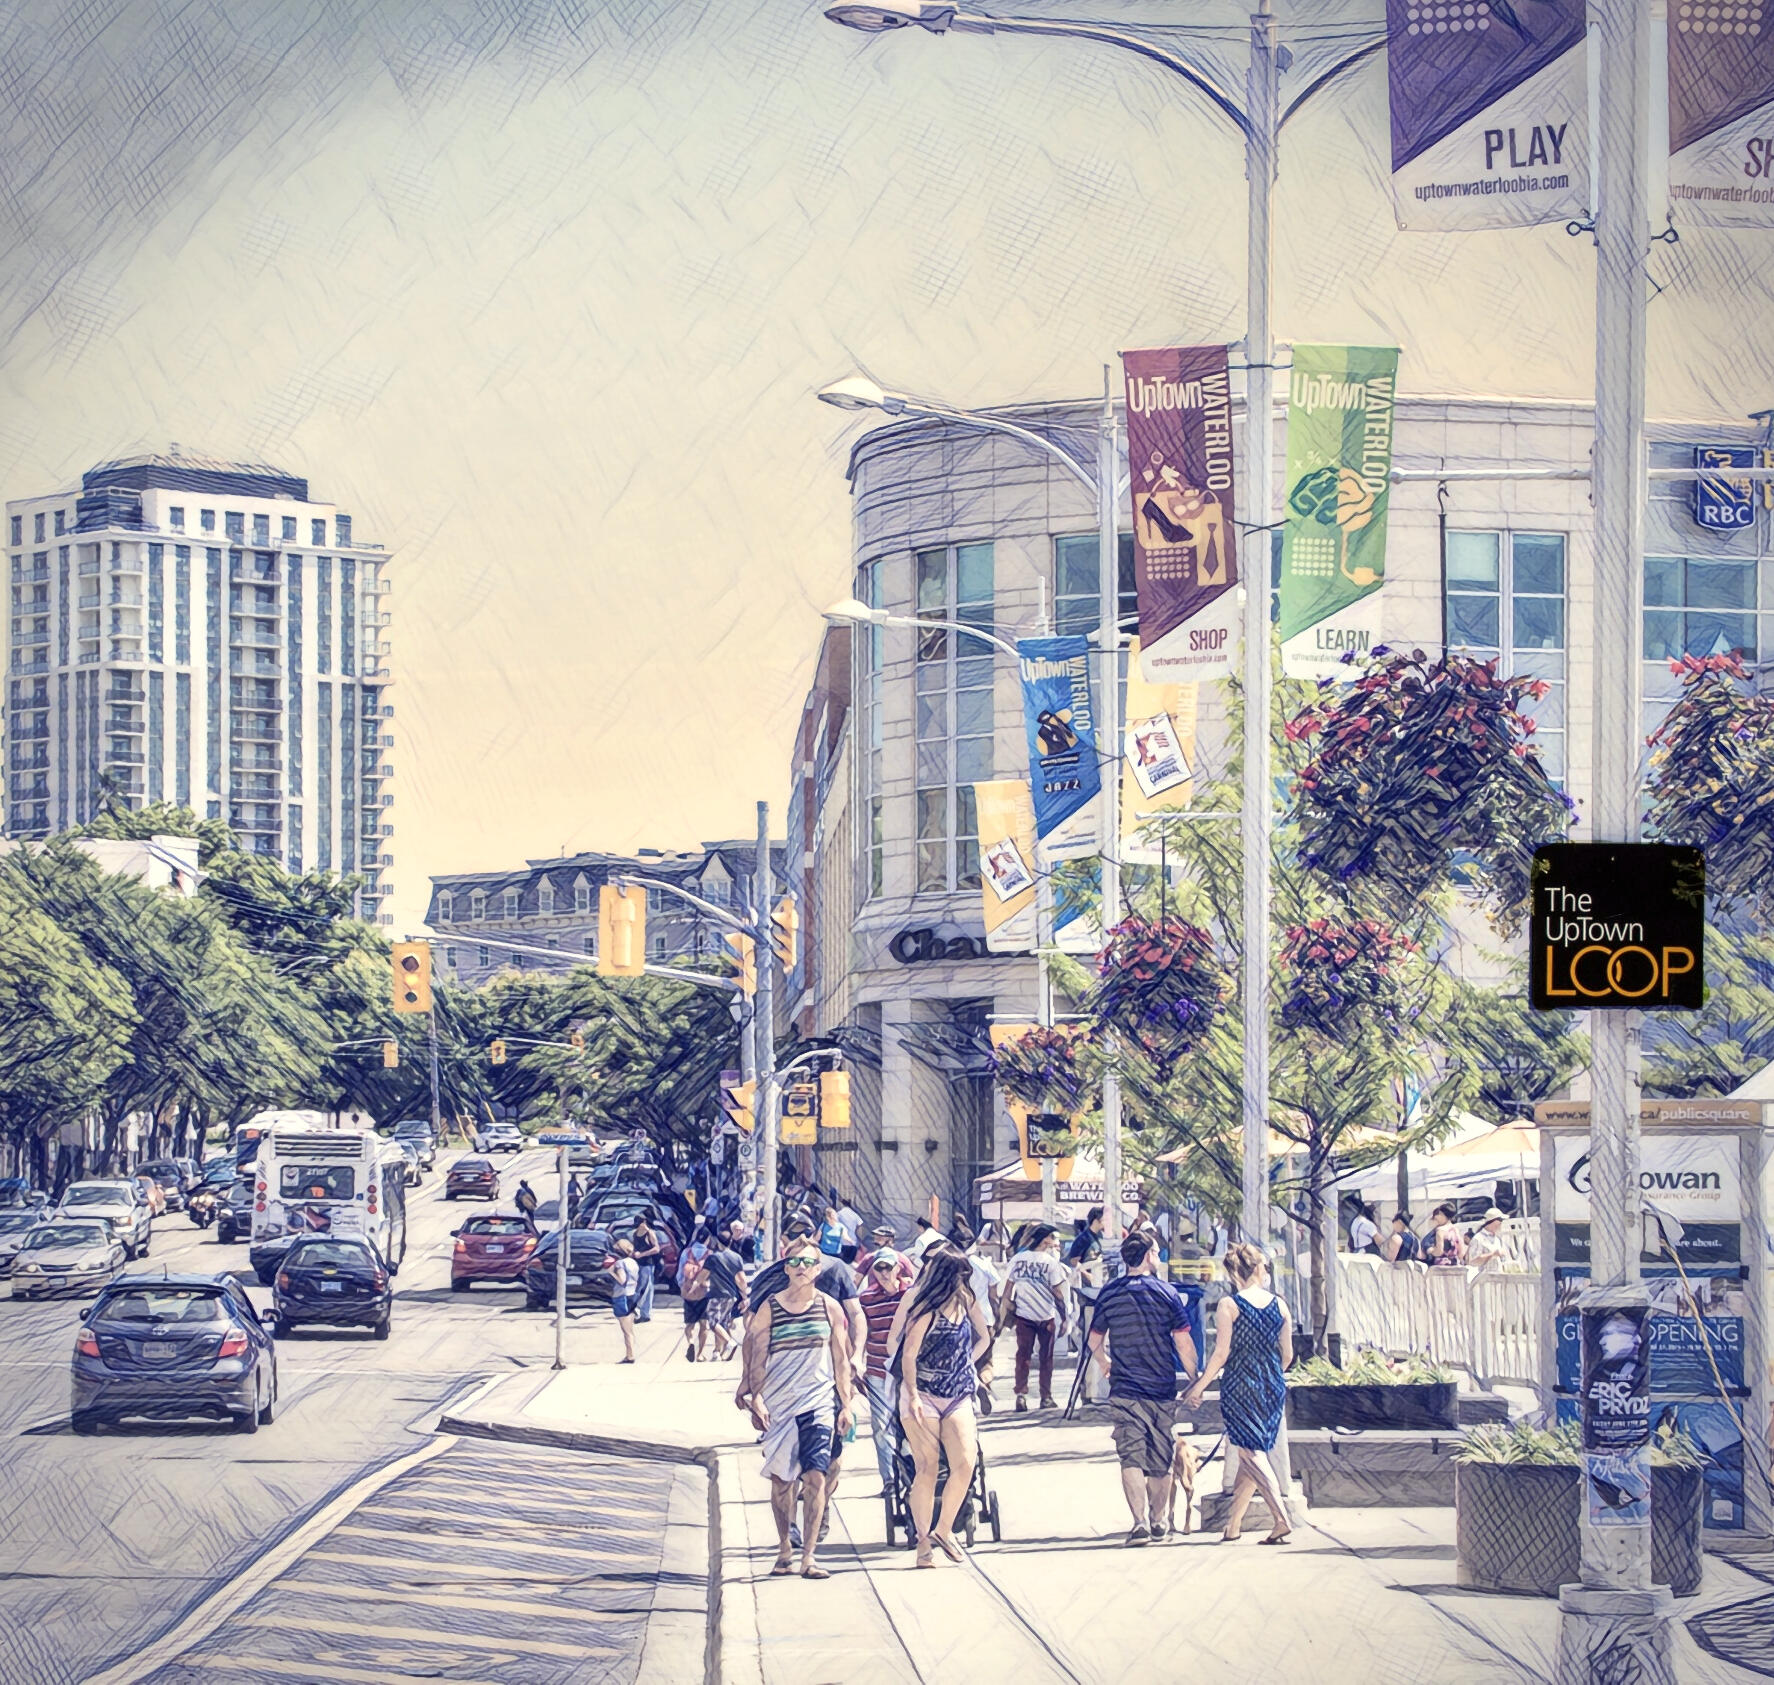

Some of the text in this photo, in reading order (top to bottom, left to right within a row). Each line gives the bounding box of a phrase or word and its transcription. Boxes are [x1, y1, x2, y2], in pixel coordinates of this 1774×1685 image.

[1484, 123, 1568, 170] PLAY
[1415, 174, 1569, 202] uptownwaterloobia.com
[1128, 376, 1203, 418] UpTown
[1293, 373, 1366, 415] UpTown
[1201, 372, 1231, 490] WATERLOO
[1361, 377, 1393, 493] WATERLOO
[1704, 505, 1750, 524] RBC
[1189, 629, 1228, 650] SHOP
[1316, 629, 1370, 651] LEARN
[1069, 655, 1091, 731] WATERLOO
[1044, 778, 1081, 793] JAZZ
[1545, 886, 1592, 912] The
[1546, 916, 1643, 947] UpTown
[1547, 945, 1694, 997] LOOP
[1640, 1171, 1721, 1190] owan
[1641, 1191, 1687, 1200] nsurance
[1588, 1381, 1632, 1399] ERIC
